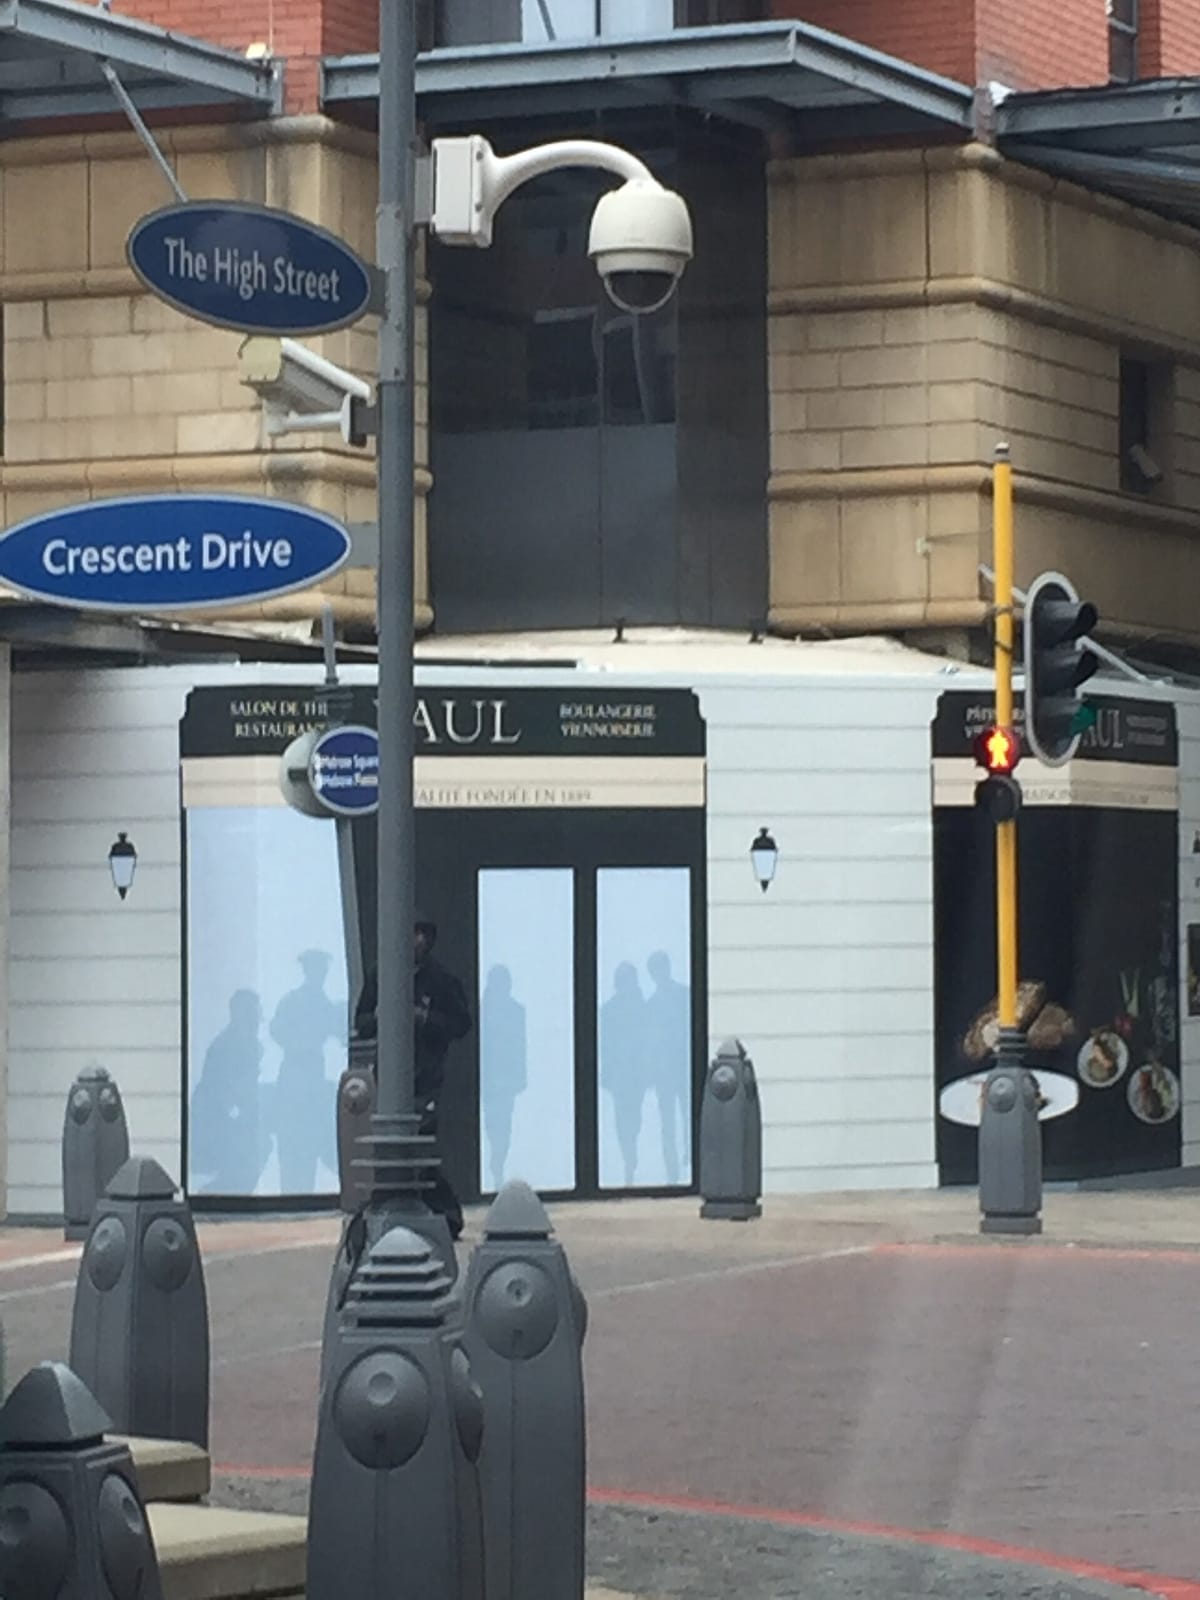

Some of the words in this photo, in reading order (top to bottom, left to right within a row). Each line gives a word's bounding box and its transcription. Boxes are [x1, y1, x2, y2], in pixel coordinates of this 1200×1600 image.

[164, 237, 208, 281] The
[214, 247, 267, 300] High
[273, 256, 340, 302] Street
[43, 537, 192, 575] Crescent
[202, 531, 291, 570] Drive
[230, 700, 277, 717] SALON
[280, 700, 299, 717] DE
[374, 698, 522, 743] AUL
